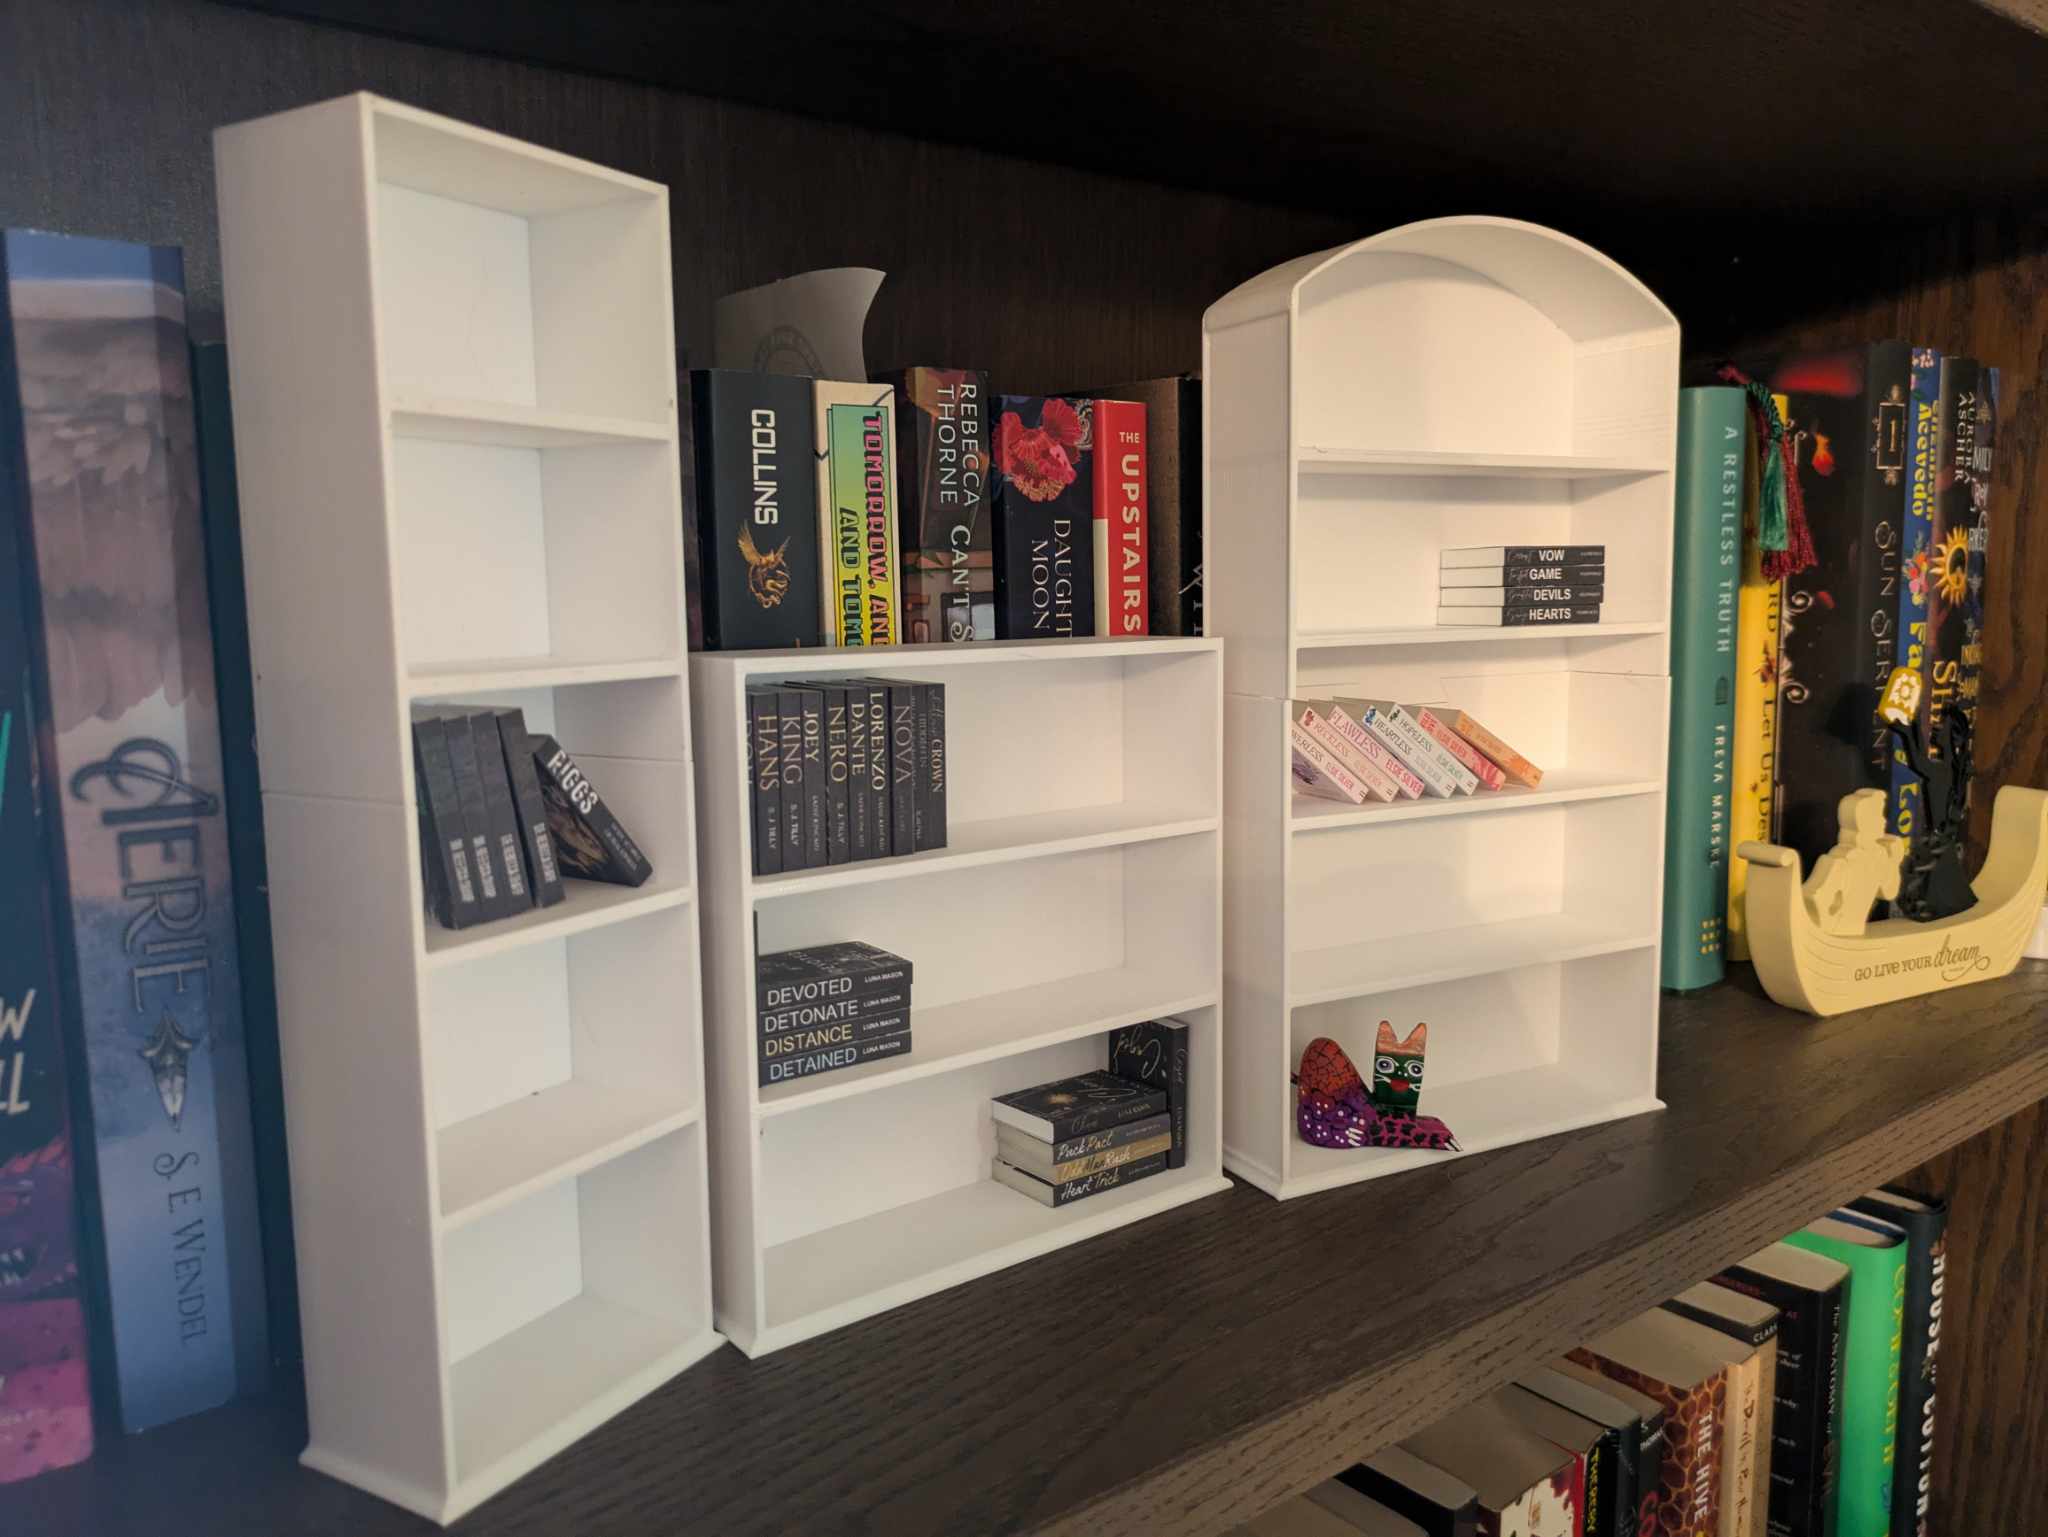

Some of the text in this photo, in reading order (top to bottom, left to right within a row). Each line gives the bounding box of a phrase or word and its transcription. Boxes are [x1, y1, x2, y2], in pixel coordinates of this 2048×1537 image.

[750, 409, 779, 526] COLLINS
[936, 383, 960, 505] THORNE
[960, 383, 981, 507] REBECCA
[1912, 402, 1932, 517] Acevedo
[1954, 393, 1968, 482] ASCHER
[1963, 391, 1976, 485] AURORA
[838, 507, 861, 570] AND
[862, 412, 889, 590] TOMORROW,
[1119, 431, 1143, 633] THE UPSTAIRS
[1716, 425, 1739, 654] A RESTLESS TRUTH
[949, 525, 972, 609] CAN'T
[1031, 539, 1051, 631] MOON
[1052, 518, 1074, 639] DAUGHT
[1528, 567, 1563, 581] GAME
[1533, 588, 1572, 601] DEVILS
[1538, 549, 1566, 562] VOW
[1874, 520, 1897, 597] SUN
[1528, 607, 1572, 621] HEARTS
[758, 714, 780, 792] HANS
[781, 715, 803, 785] KING
[803, 709, 820, 763] JOEY
[828, 705, 848, 783] NERO
[851, 703, 866, 776] DANTE
[869, 691, 887, 792] LORENZO
[894, 705, 913, 784] NOVA
[930, 738, 945, 793] CROWN
[1329, 706, 1382, 760] FLAWLESS
[1713, 724, 1728, 784] FREYA
[767, 976, 853, 1007] DEVOTED
[1855, 966, 1872, 982] GO
[1901, 955, 1933, 973] YOUR
[1933, 934, 1986, 976] dream
[765, 999, 859, 1033] DETONATE
[765, 1023, 853, 1057] DISTANCE
[770, 1047, 857, 1080] DETAINED
[168, 1219, 208, 1346] WENDEL
[1693, 1411, 1713, 1523] THE HIVE
